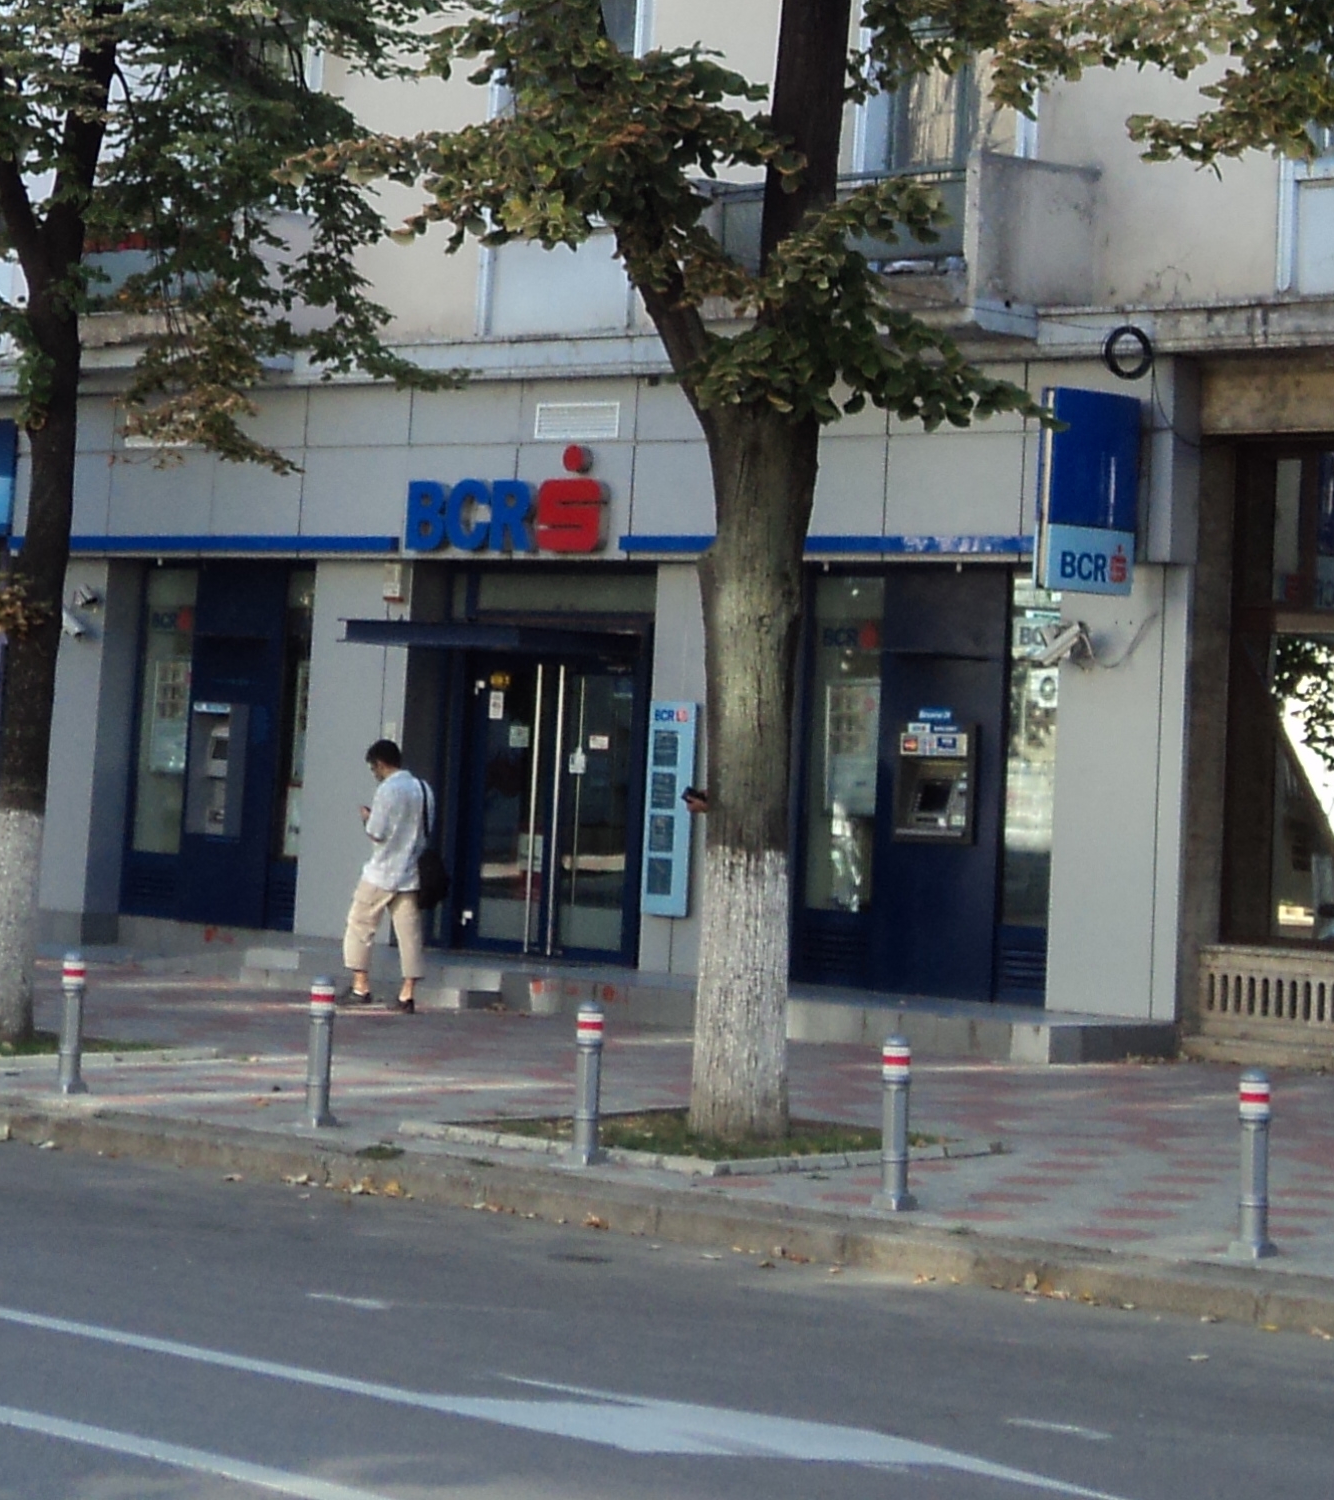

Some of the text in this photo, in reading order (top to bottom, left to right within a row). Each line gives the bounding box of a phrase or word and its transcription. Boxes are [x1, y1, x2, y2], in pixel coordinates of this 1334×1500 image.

[405, 478, 533, 552] BCR
[1060, 550, 1107, 583] BCR
[654, 708, 675, 722] BCR
